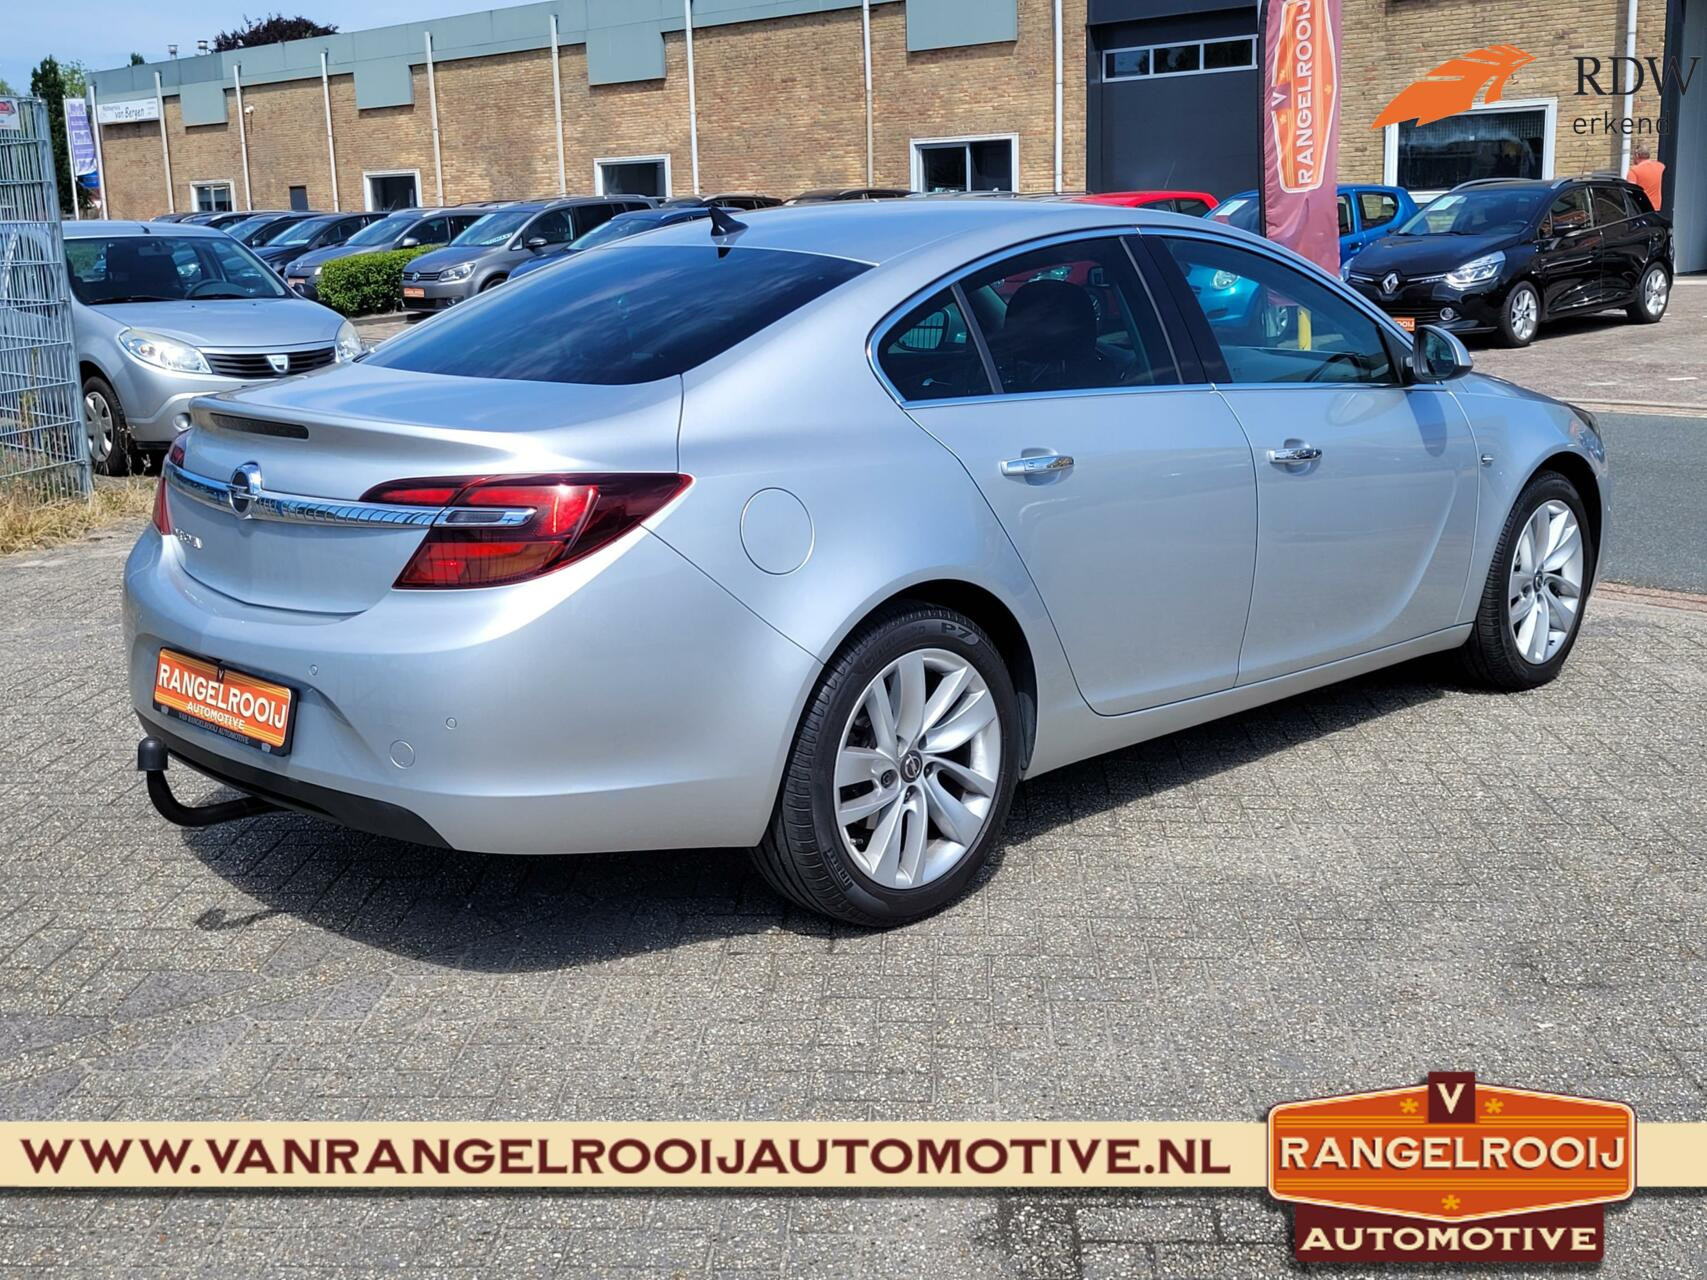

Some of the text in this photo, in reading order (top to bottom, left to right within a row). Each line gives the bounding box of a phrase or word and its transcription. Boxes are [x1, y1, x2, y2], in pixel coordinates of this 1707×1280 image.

[1271, 92, 1287, 106] V
[1296, 0, 1314, 184] RANGELROOIJ
[218, 670, 224, 679] V
[158, 663, 287, 729] RANGELROOIJ
[186, 701, 246, 730] AUTOMOTIVE
